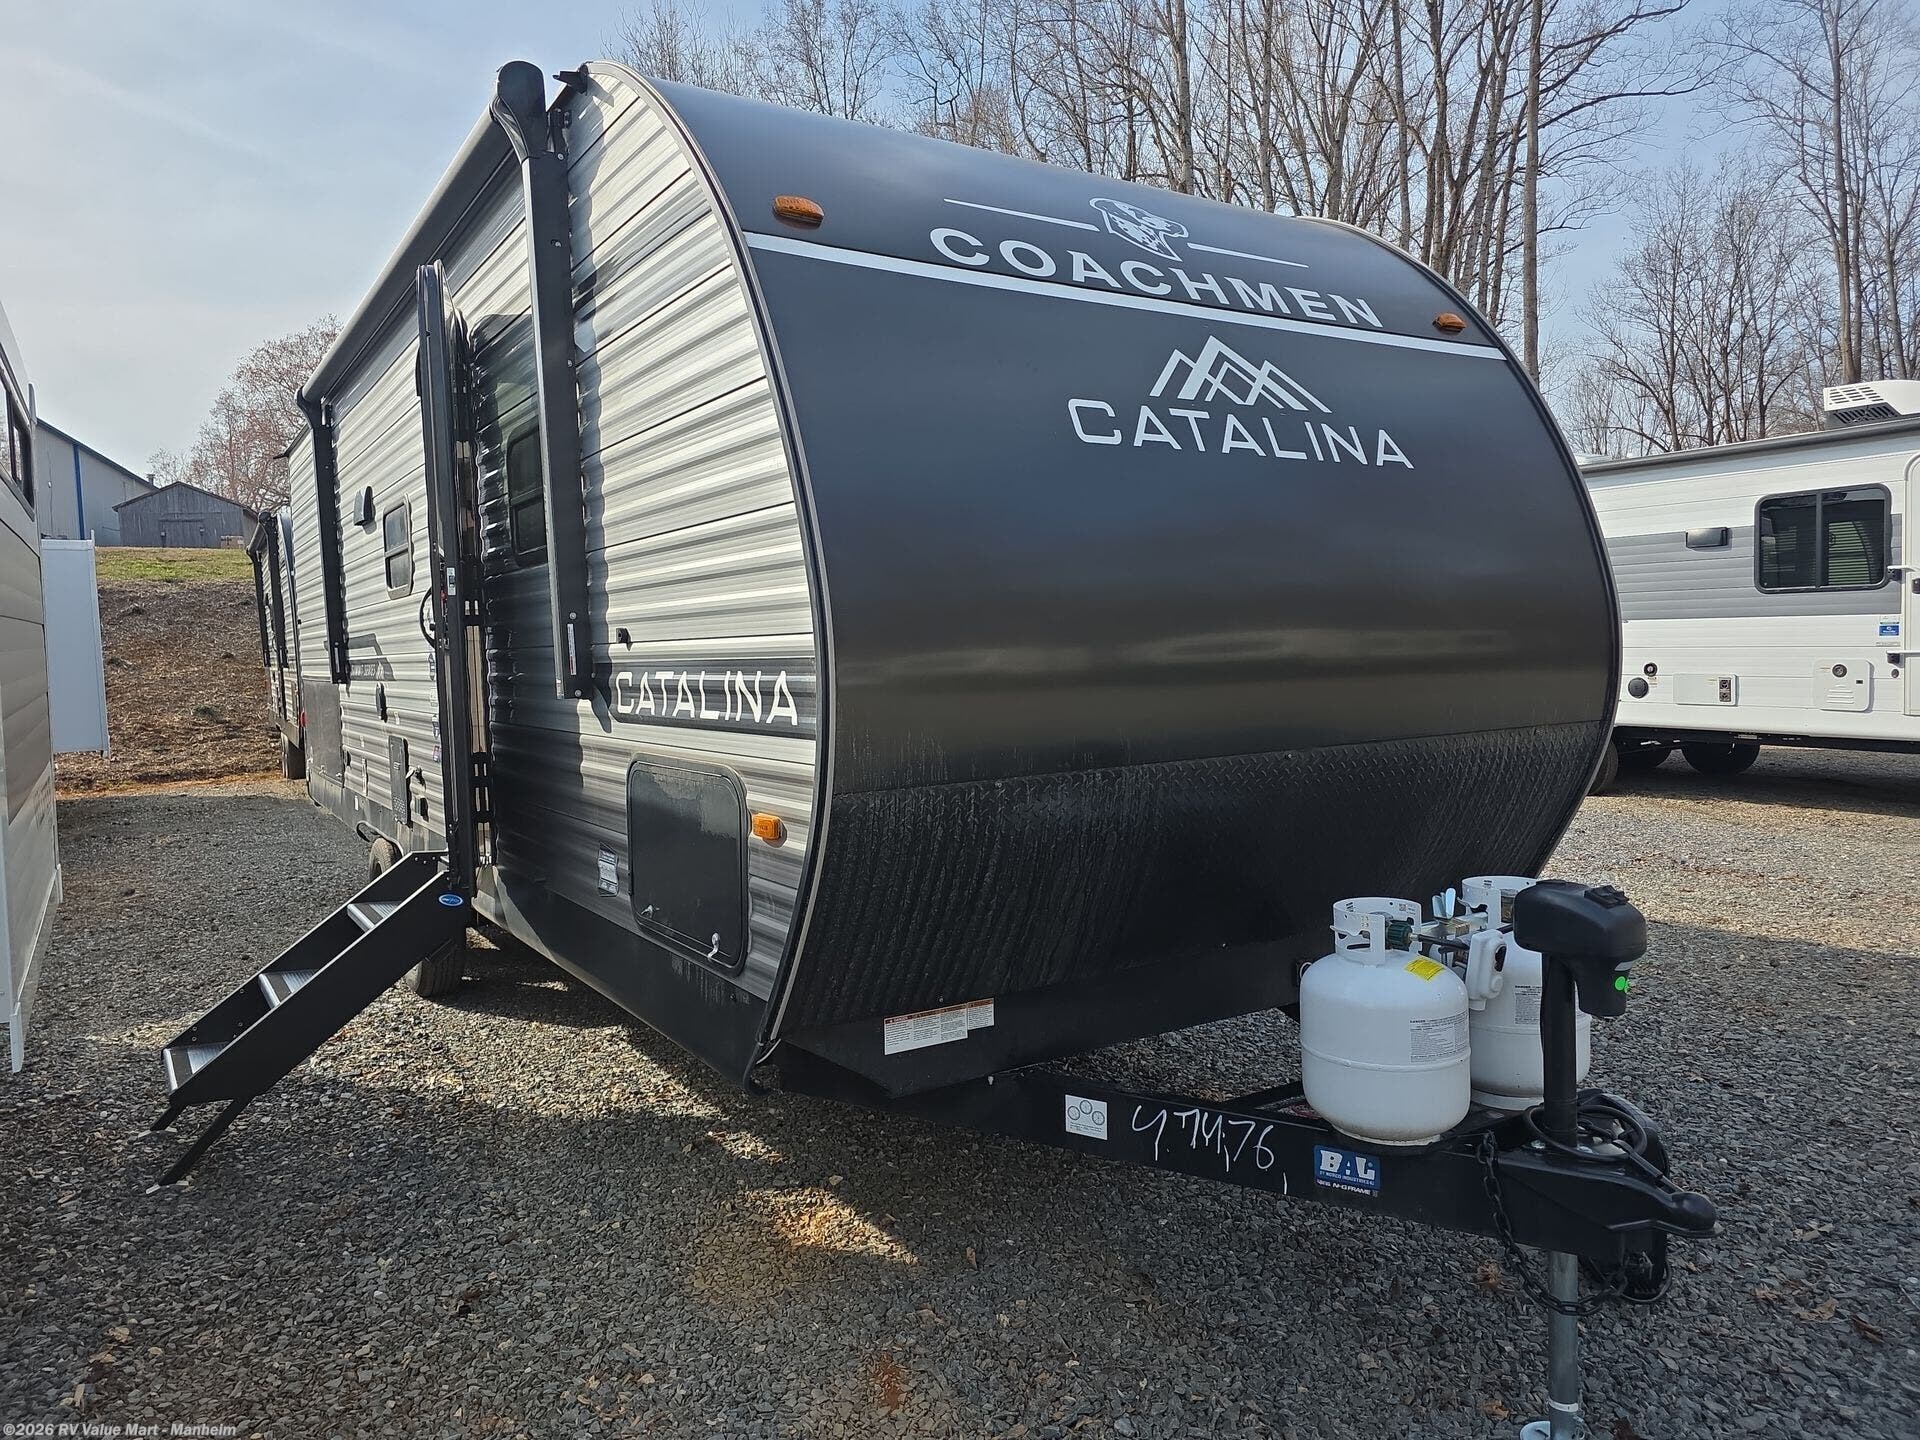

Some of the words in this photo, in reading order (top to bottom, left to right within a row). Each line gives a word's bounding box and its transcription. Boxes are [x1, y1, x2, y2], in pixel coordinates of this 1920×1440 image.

[929, 227, 1383, 328] COACHMEN
[1067, 398, 1415, 469] CATALINA
[615, 670, 798, 726] CATALINA
